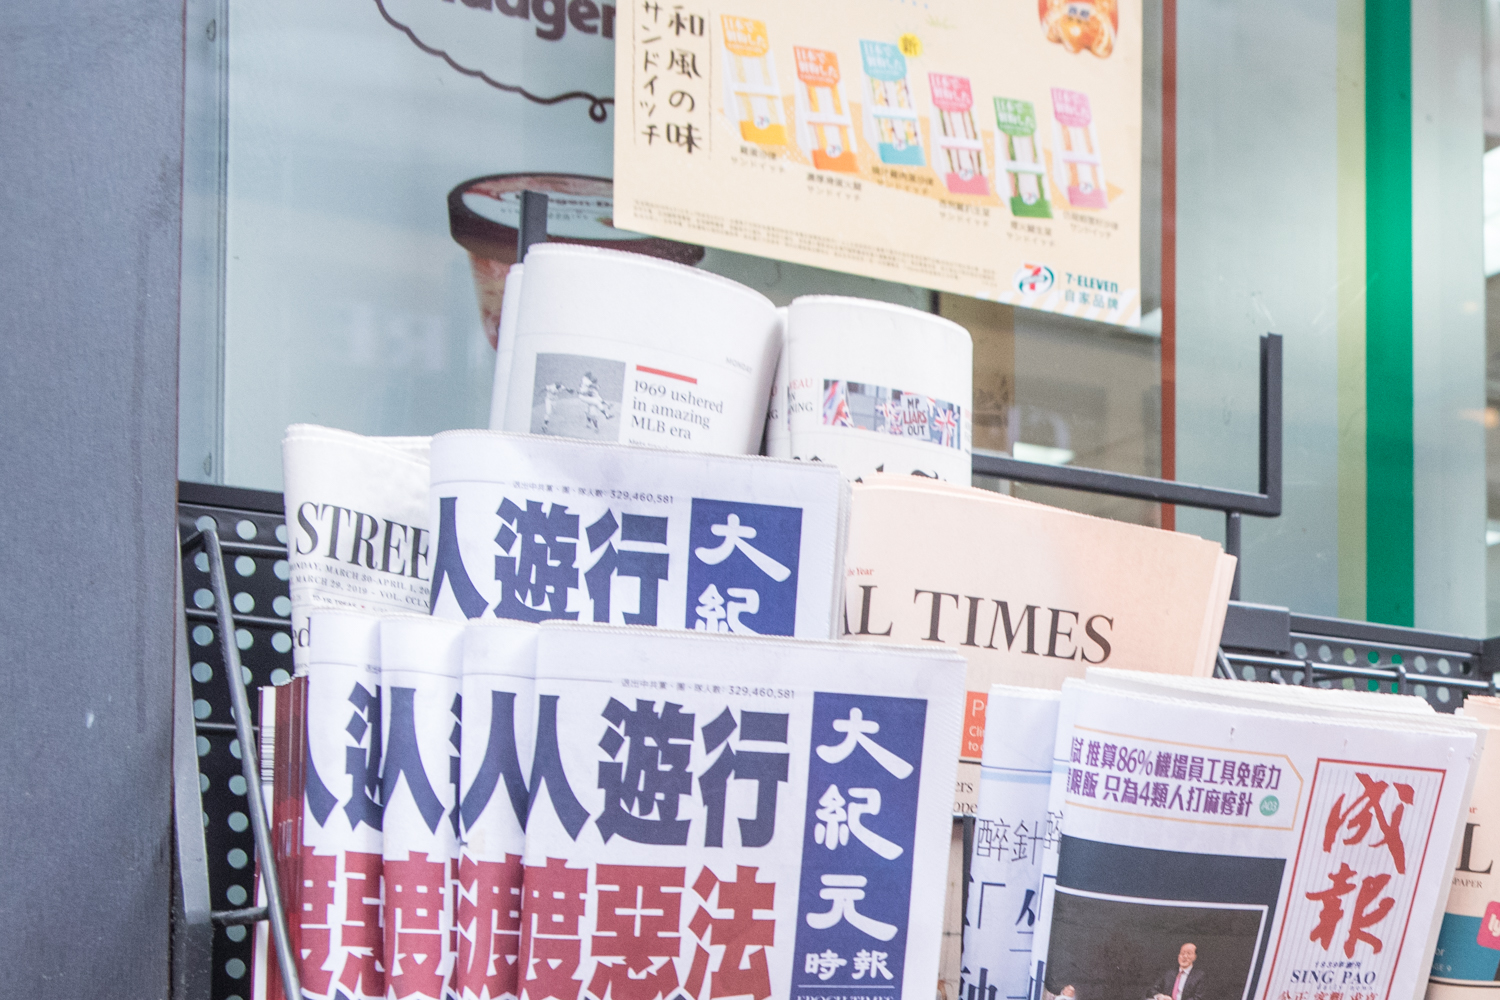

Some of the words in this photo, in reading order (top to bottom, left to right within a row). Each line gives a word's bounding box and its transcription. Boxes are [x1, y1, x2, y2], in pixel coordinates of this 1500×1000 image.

[667, 5, 704, 153] 和風の味
[1064, 290, 1119, 310] 自家品牌
[634, 379, 667, 398] 1969
[671, 388, 724, 415] ushered
[630, 415, 666, 433] MLB
[670, 427, 693, 441] era
[632, 398, 647, 412] in
[651, 403, 711, 430] amazing
[903, 410, 928, 425] LIARS
[907, 425, 926, 436] OUT
[609, 488, 675, 505] 329,460,581
[912, 587, 1116, 666] TIMES
[728, 685, 796, 700] 329,460,581
[527, 694, 790, 849] 人遊行
[805, 705, 914, 942] 大紀元
[976, 818, 1043, 866] 醉針
[1305, 771, 1416, 960] 成報
[804, 949, 895, 981] 時報
[1290, 969, 1335, 985] SING
[1342, 969, 1377, 986] PAO
